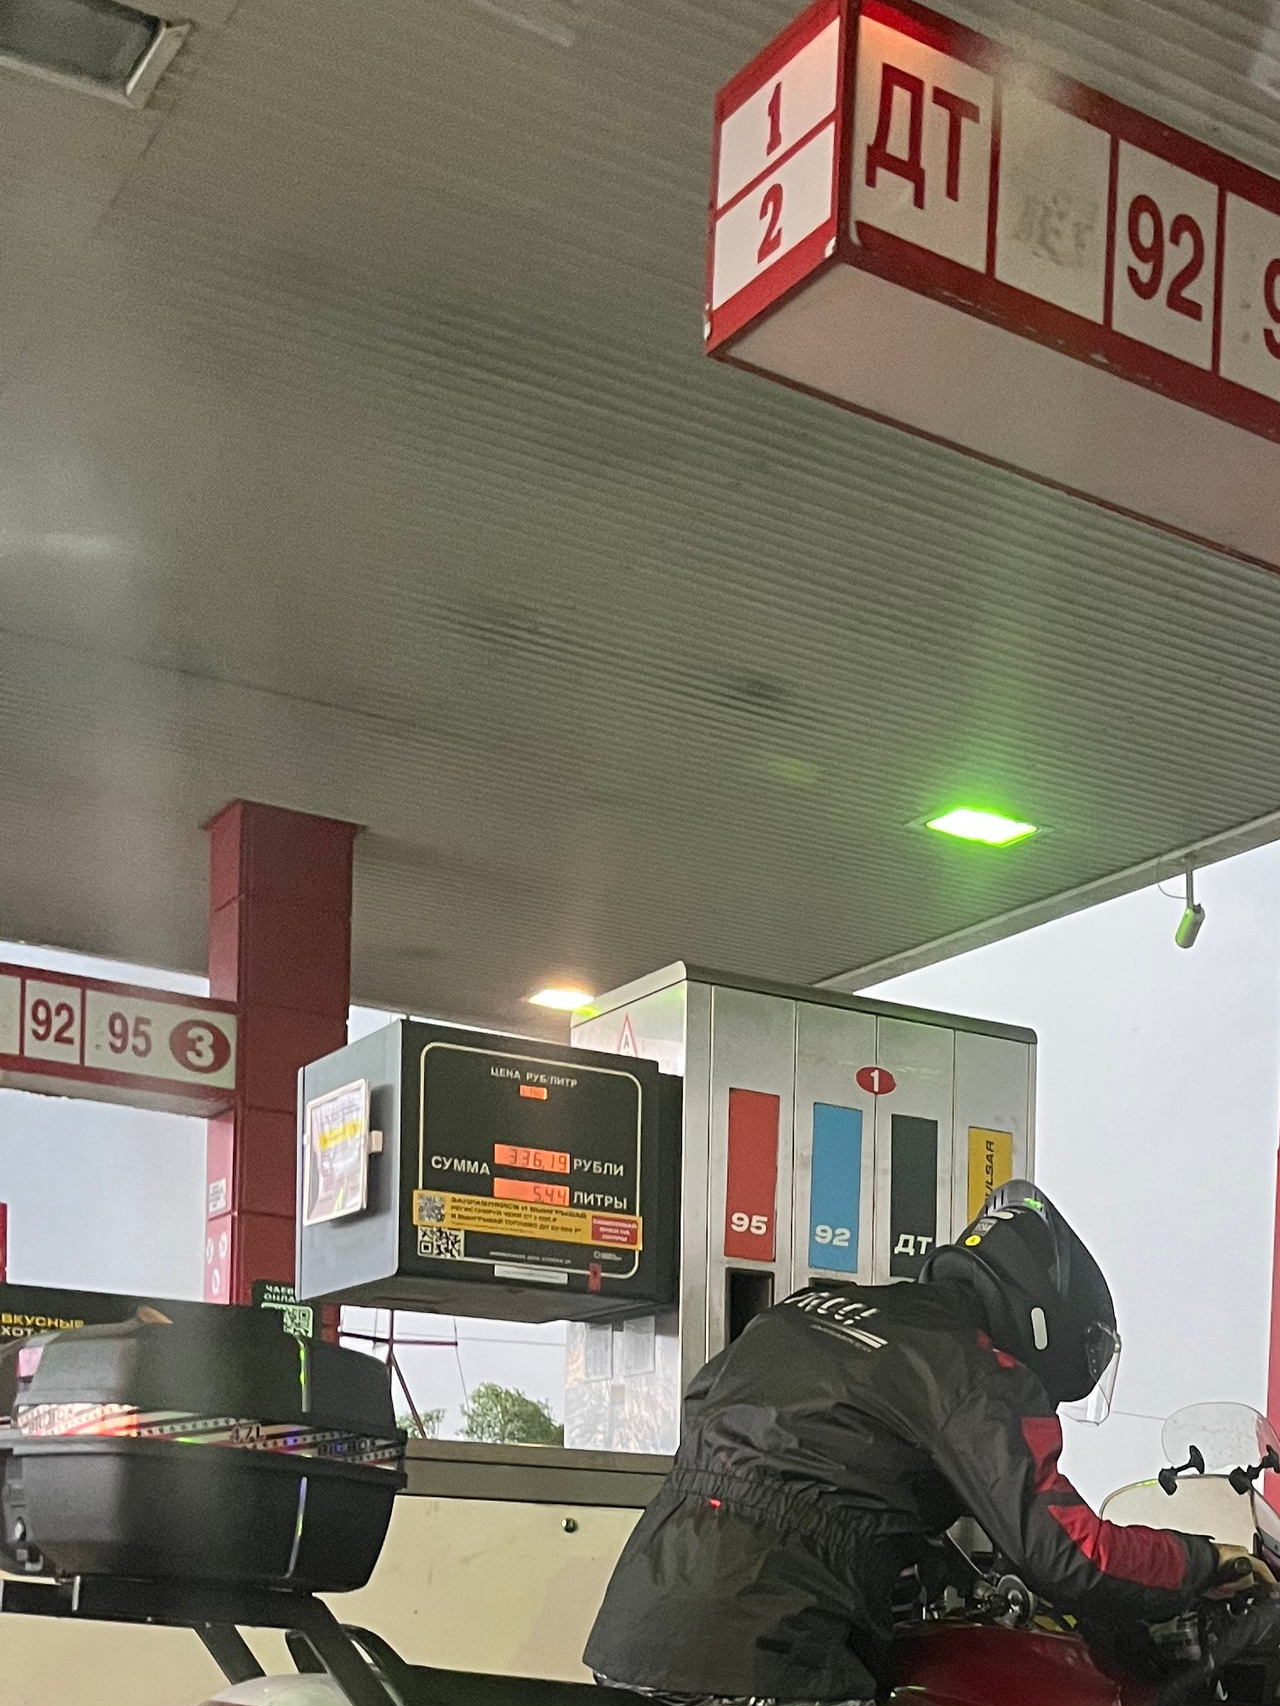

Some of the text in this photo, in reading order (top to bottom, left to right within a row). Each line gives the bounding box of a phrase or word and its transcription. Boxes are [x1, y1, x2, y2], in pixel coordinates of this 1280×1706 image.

[766, 82, 782, 157] 1
[864, 62, 981, 210] ДТ
[1126, 193, 1205, 322] 92
[757, 183, 783, 265] 2
[31, 999, 215, 1067] 92 95 3
[490, 1066, 521, 1080] ЦЕНА
[870, 1069, 880, 1093] 1
[431, 1155, 491, 1176] СУММА
[573, 1157, 625, 1177] РУБЛИ
[985, 1140, 995, 1200] ULSAR
[573, 1190, 628, 1210] ЛИТРЫ
[730, 1211, 769, 1235] 95
[815, 1223, 851, 1247] 92
[893, 1232, 933, 1257] ДТ
